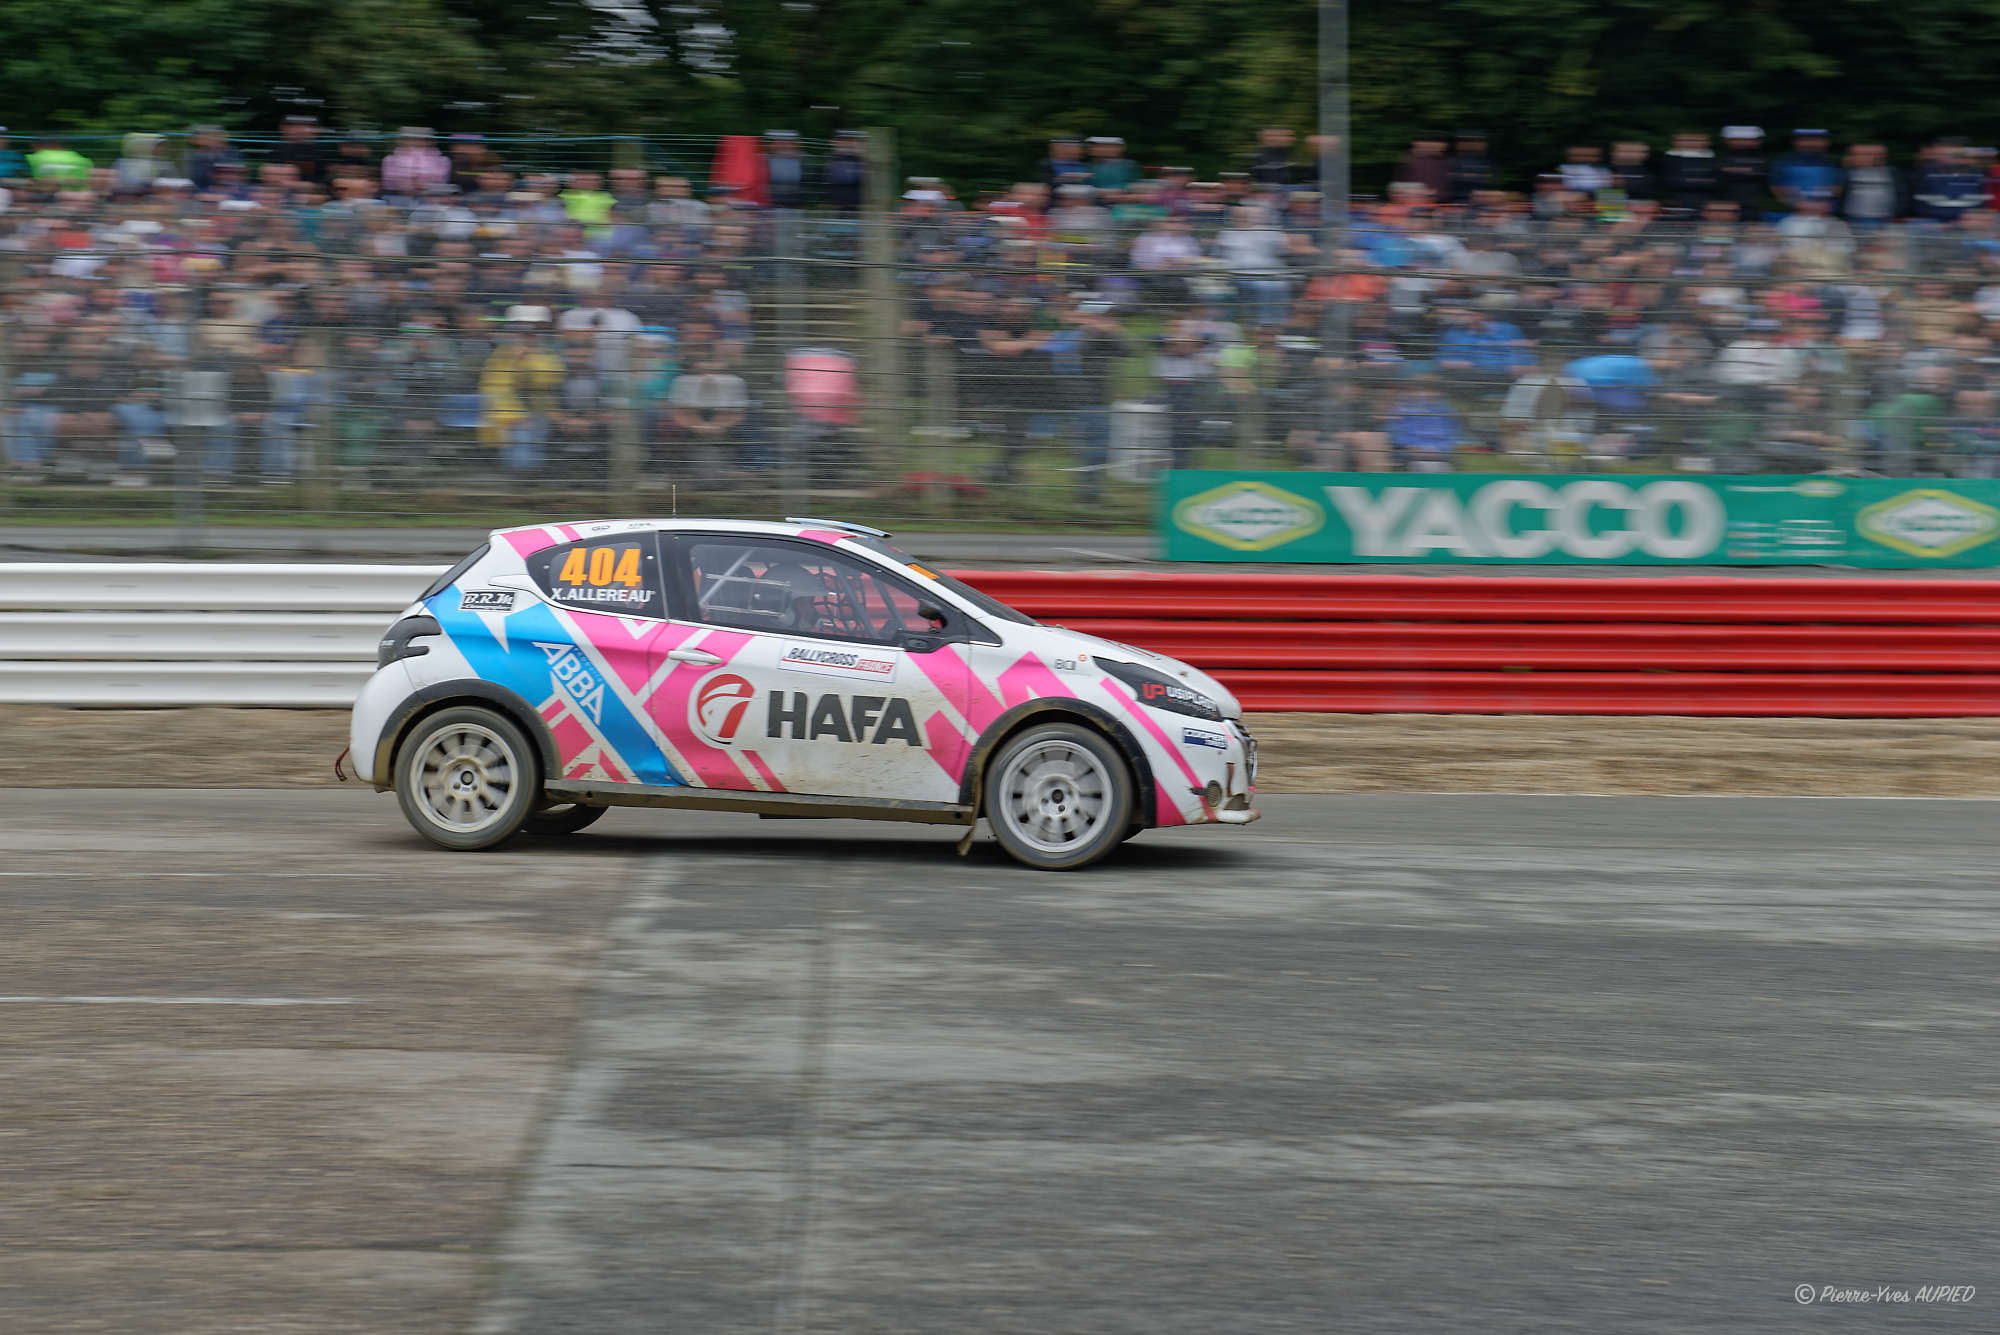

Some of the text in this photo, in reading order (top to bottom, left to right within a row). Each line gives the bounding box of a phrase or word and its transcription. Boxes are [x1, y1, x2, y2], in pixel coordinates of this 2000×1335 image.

[1321, 480, 1727, 559] YACCO
[559, 547, 642, 586] 404
[551, 587, 653, 602] X.ALLEREAU
[788, 647, 858, 666] RALLYCROSS
[531, 641, 604, 725] ABBA
[767, 690, 922, 746] HAFA
